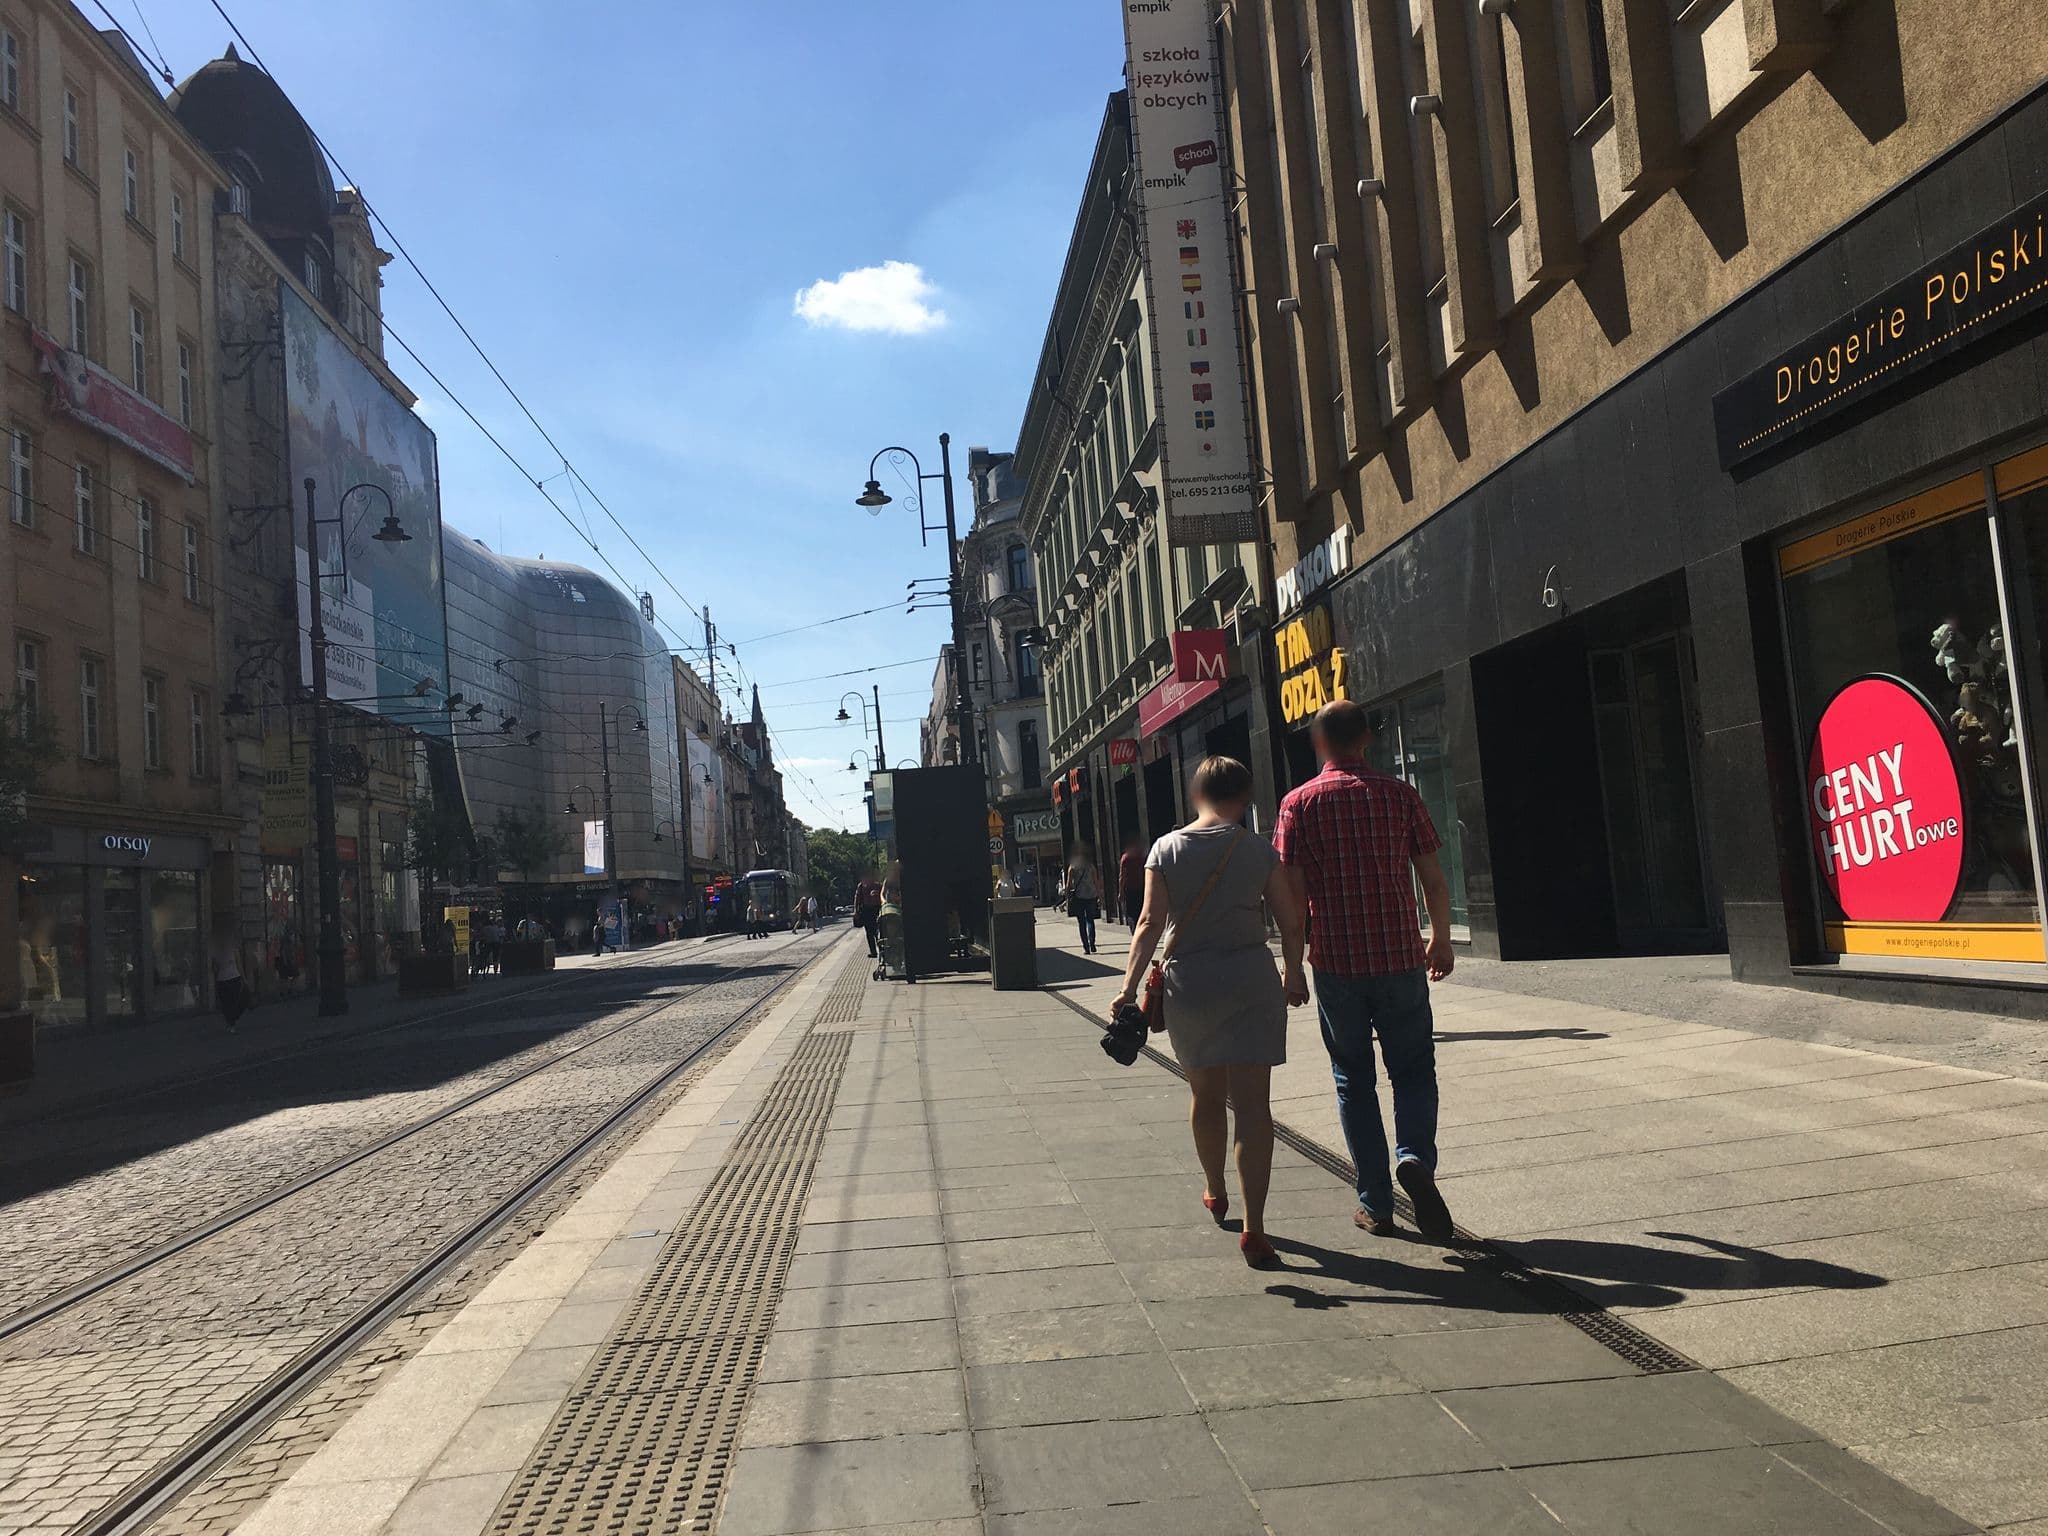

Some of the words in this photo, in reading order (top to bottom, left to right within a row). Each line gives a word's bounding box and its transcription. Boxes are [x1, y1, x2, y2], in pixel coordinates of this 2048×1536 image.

[1129, 0, 1171, 14] empik
[1142, 46, 1201, 62] szkoła
[1136, 69, 1210, 89] języków
[1143, 92, 1208, 110] obcych
[1177, 145, 1214, 163] school
[1144, 174, 1187, 189] empik
[1776, 307, 1905, 404] Drogerie
[1171, 489, 1188, 498] tel.
[1189, 487, 1209, 497] 695
[1210, 486, 1230, 496] 213
[1231, 484, 1251, 494] 684
[1835, 524, 1876, 547] Drogerie
[1879, 507, 1916, 530] Polskie
[1276, 523, 1352, 616] DYSKONT
[1542, 564, 1559, 608] 6
[1194, 650, 1227, 681] M
[1113, 742, 1135, 763] illy
[1813, 743, 1904, 824] CENY
[104, 834, 151, 860] orsay
[989, 840, 1003, 850] 20
[1820, 798, 1959, 876] HURTowe
[1885, 937, 1971, 949] www.drogeriepolskie.pl
